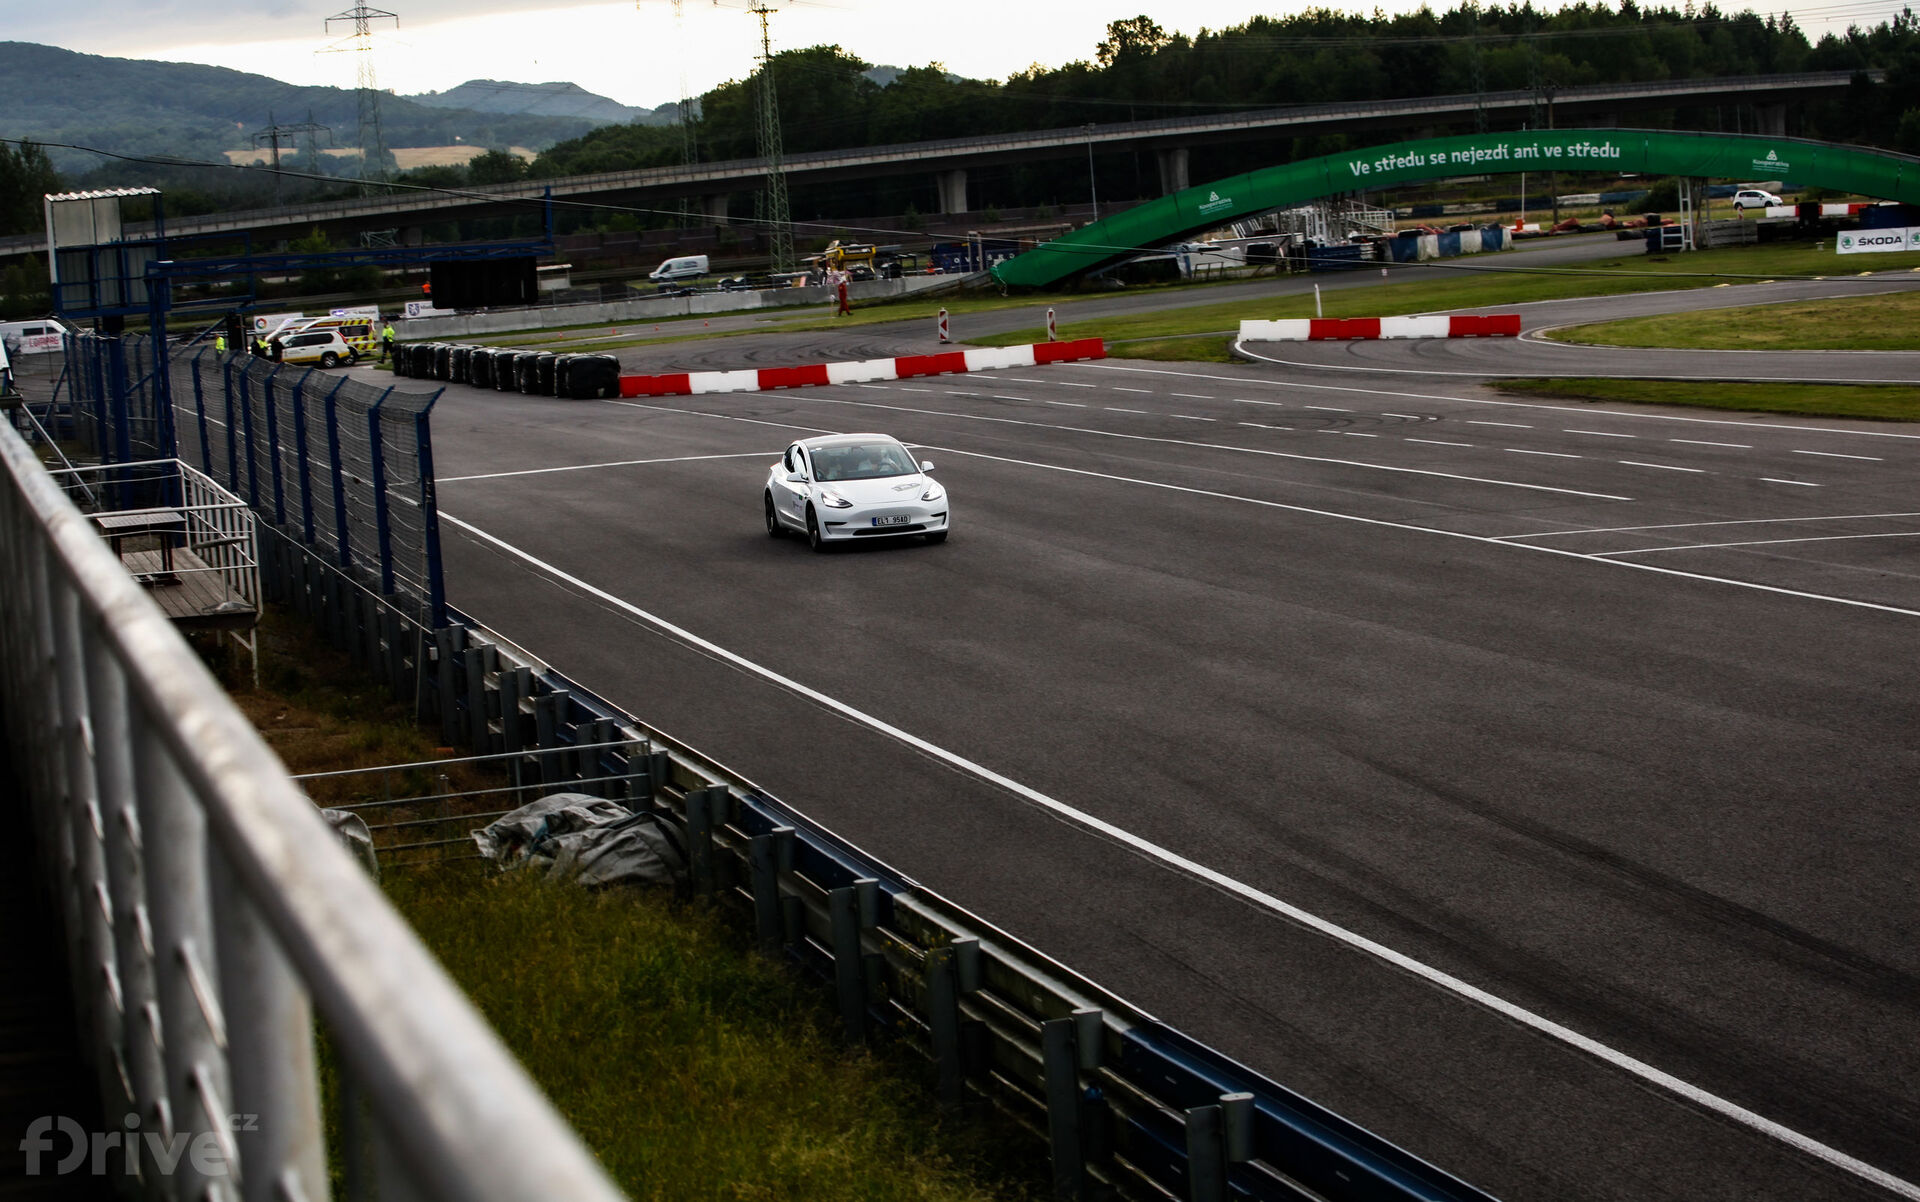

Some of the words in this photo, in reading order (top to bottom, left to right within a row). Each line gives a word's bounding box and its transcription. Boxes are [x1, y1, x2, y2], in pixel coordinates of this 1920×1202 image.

[1349, 160, 1370, 176] Ve
[1374, 151, 1425, 172] středu
[1429, 152, 1446, 165] se
[1451, 143, 1509, 165] nejezdí
[1513, 143, 1540, 158] ani
[1543, 146, 1563, 157] ve
[1567, 141, 1620, 158] středu
[1858, 236, 1902, 246] ŠKODA
